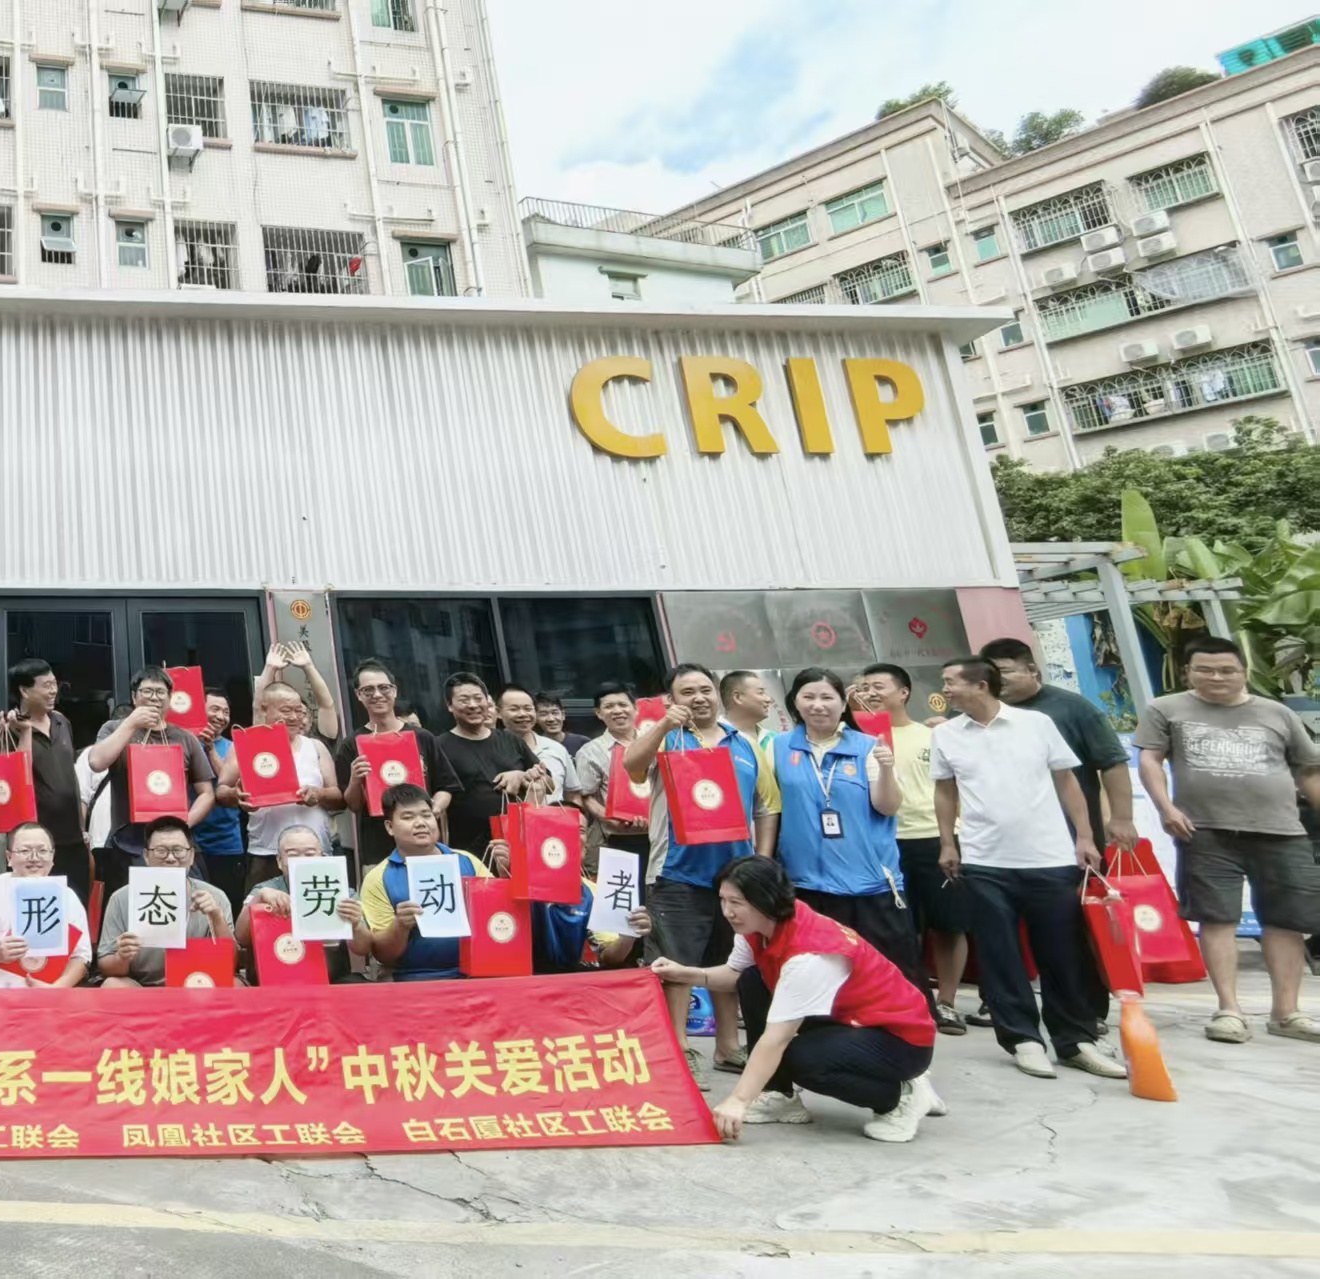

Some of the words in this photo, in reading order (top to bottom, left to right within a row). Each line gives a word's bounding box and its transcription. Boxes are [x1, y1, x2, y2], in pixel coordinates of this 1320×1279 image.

[570, 355, 925, 459] CRIP
[138, 885, 178, 926] 态
[300, 875, 340, 917] 劳
[418, 875, 455, 915] 动
[604, 869, 636, 913] 者
[22, 896, 61, 935] 形
[122, 1120, 367, 1147] 凤凰社区工联会
[401, 1101, 675, 1142] 白石厦社区工联会
